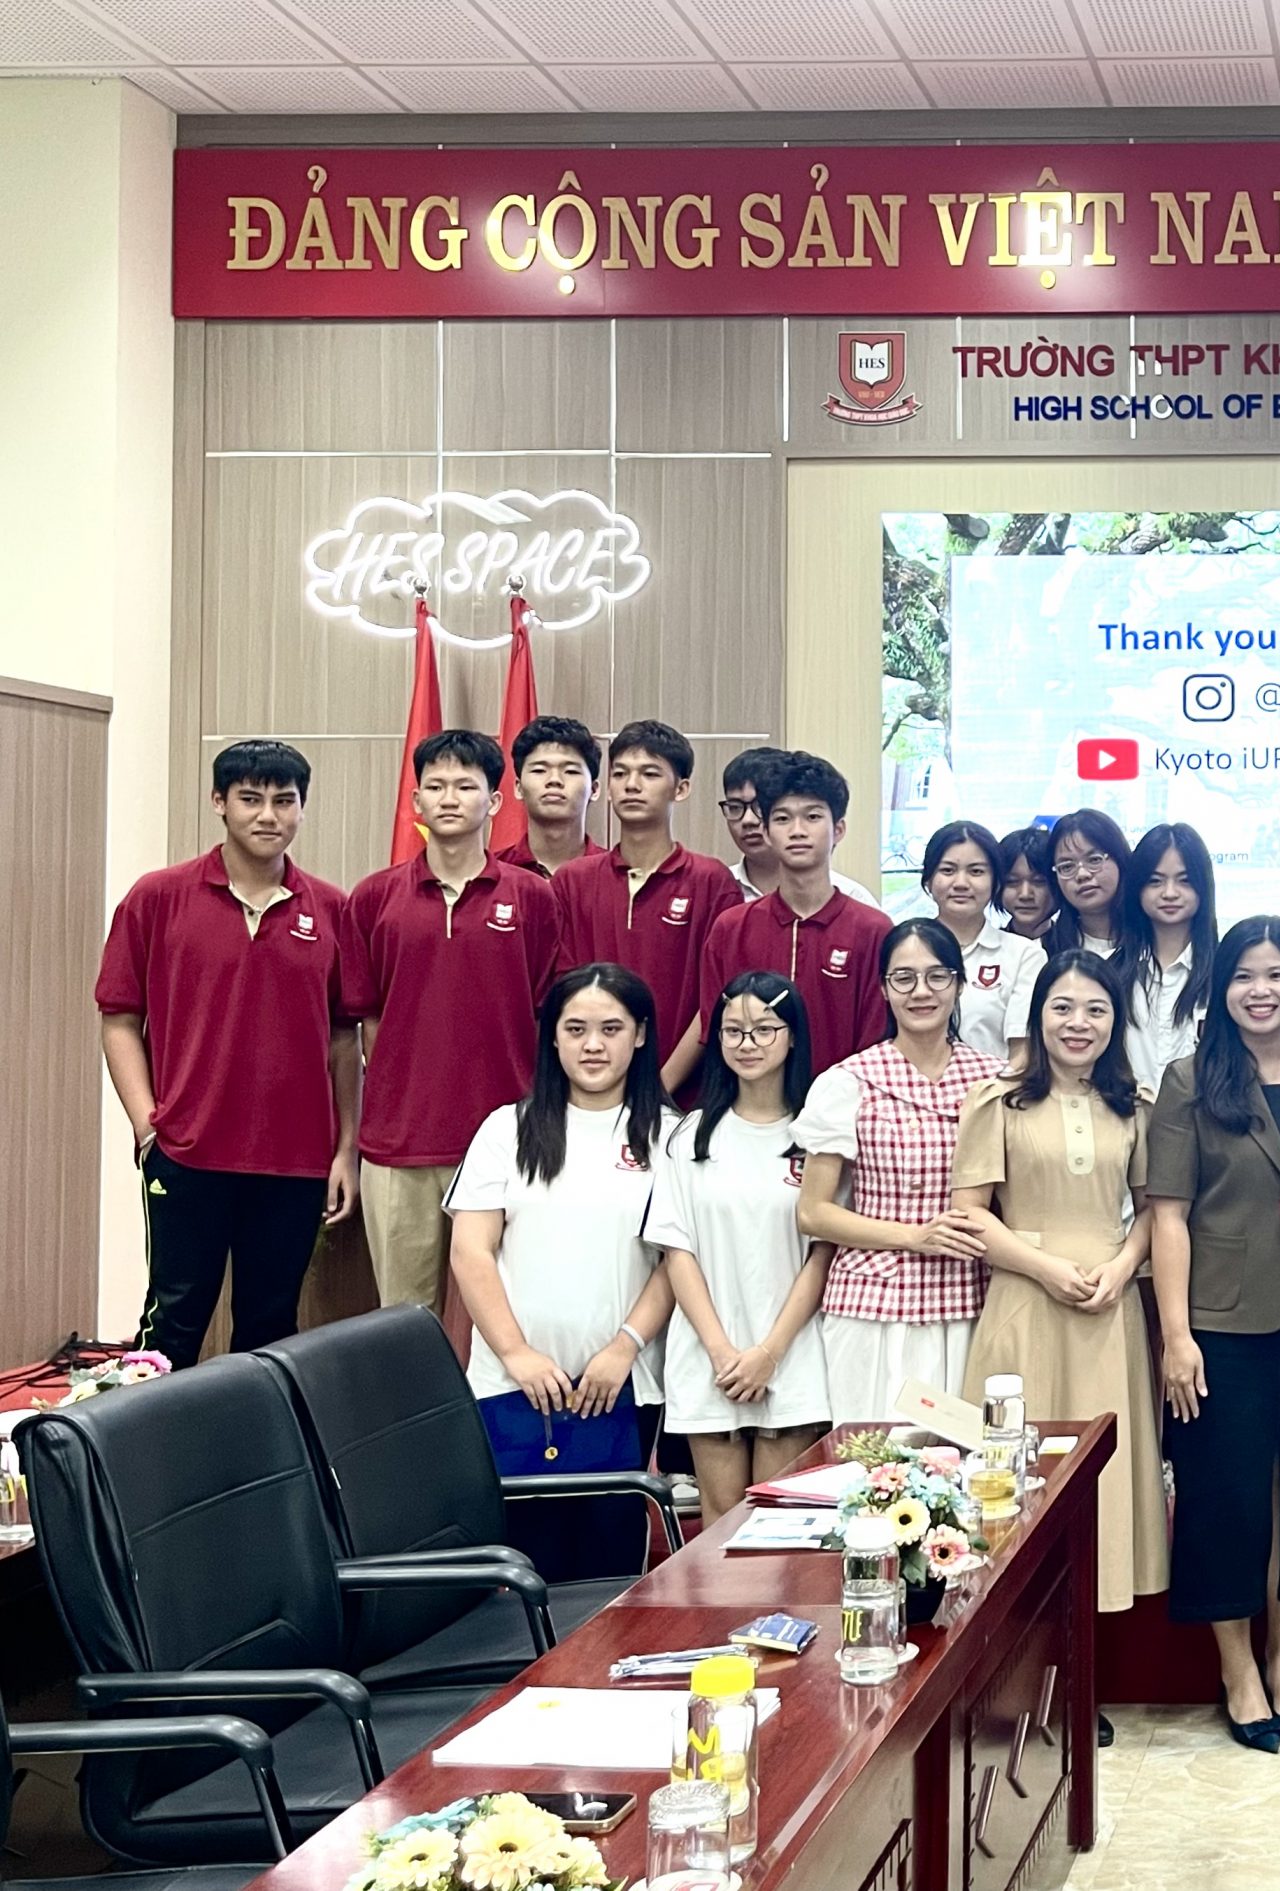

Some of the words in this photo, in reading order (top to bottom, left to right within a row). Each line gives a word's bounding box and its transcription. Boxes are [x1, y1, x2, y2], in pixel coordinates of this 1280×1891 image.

[226, 164, 469, 272] ĐẢNG
[485, 169, 721, 295] CỘNG
[739, 163, 908, 270] SẢN
[928, 166, 1125, 290] VIỆT
[858, 357, 886, 369] HES
[952, 335, 1115, 378] TRƯỜNG
[1130, 343, 1230, 377] THPT
[1013, 395, 1083, 422] HIGH
[1090, 393, 1213, 421] SCHOOL
[1223, 393, 1263, 419] OF
[332, 530, 446, 601] HES
[443, 528, 627, 594] SPACE
[1098, 622, 1204, 651] Thank
[1215, 627, 1277, 656] you
[1155, 747, 1233, 776] Kyoto
[1208, 852, 1249, 864] ogram
